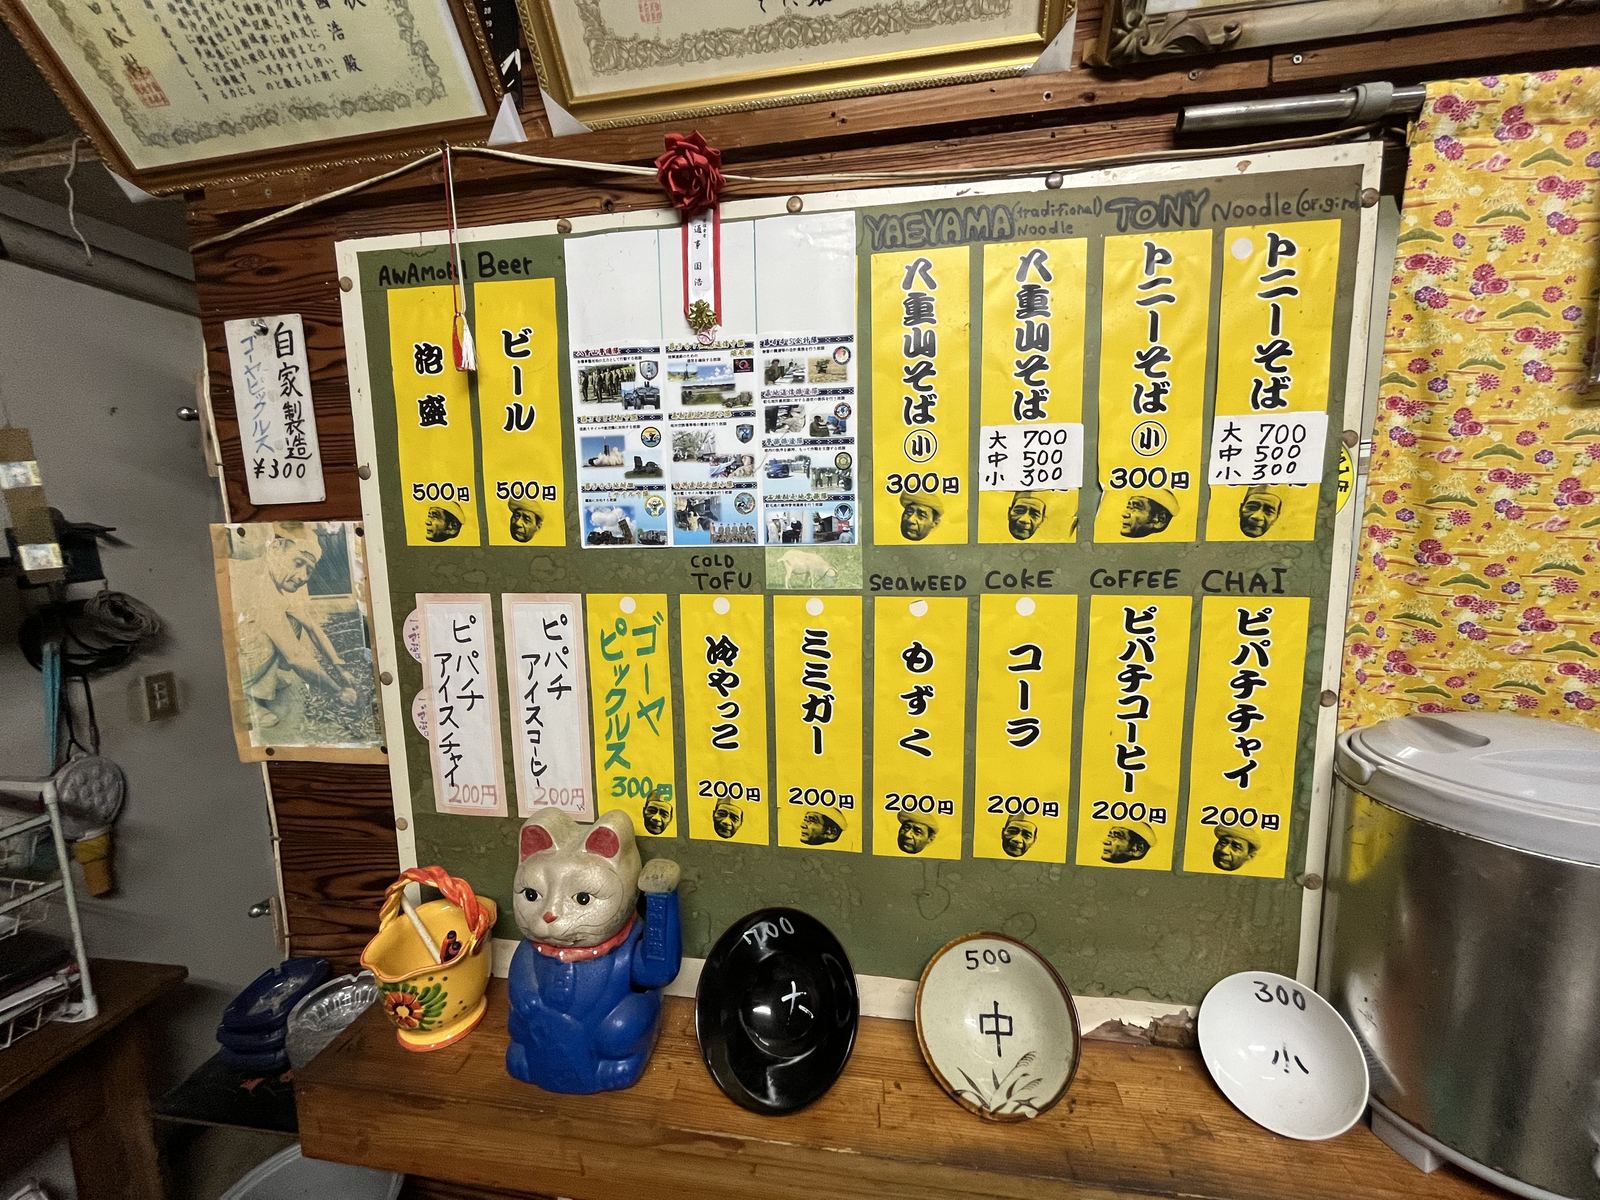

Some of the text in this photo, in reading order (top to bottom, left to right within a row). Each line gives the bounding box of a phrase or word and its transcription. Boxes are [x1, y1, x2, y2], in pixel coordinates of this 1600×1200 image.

[1104, 187, 1210, 232] TONY
[1212, 192, 1292, 222] Noodle
[478, 251, 532, 278] Beer
[1013, 247, 1053, 422] 八重山そば
[1132, 240, 1176, 415] トニーそば
[1250, 231, 1299, 411] トニーそば
[274, 322, 312, 460] 自家製造
[414, 342, 448, 428] 泡盛
[501, 327, 536, 432] ビール
[989, 429, 1067, 449] 大 700
[1220, 421, 1306, 445] 大 700
[988, 449, 1063, 468] 中 500
[1219, 444, 1301, 462] 中 500
[253, 458, 306, 479] ¥300
[985, 467, 1062, 486] 小 300
[1110, 467, 1189, 489] 300円
[1216, 461, 1297, 480] 小 300
[412, 482, 470, 501] 500円
[496, 481, 557, 501] 500円
[886, 472, 959, 494] 300円
[1201, 567, 1288, 594] CHAI
[451, 615, 484, 711] ピパチ
[541, 613, 571, 700] ピパチ
[632, 611, 665, 736] ゴーヤ
[600, 618, 631, 771] ピックルス
[705, 634, 740, 750] 冷やっこ
[801, 628, 833, 755] ミミガー
[898, 641, 934, 758] もずく
[1006, 643, 1043, 749] コーラ
[1115, 606, 1159, 793] ピパチコーヒー
[1223, 607, 1274, 790] ピパチチャイ
[434, 653, 464, 787] アイスチャイ
[449, 784, 498, 806] 200円
[533, 786, 585, 806] 200円
[611, 776, 673, 801] 300円
[699, 780, 761, 802] 200円
[788, 787, 854, 809] 200円
[885, 793, 954, 815] 200円
[987, 795, 1060, 817] 200円
[1092, 801, 1167, 823] 200円
[1200, 806, 1280, 830] 200円
[965, 947, 1012, 970] 500
[781, 980, 813, 1019] 大
[1253, 980, 1307, 1012] 300
[978, 1000, 1015, 1057] 中
[1270, 1043, 1310, 1076] 小
